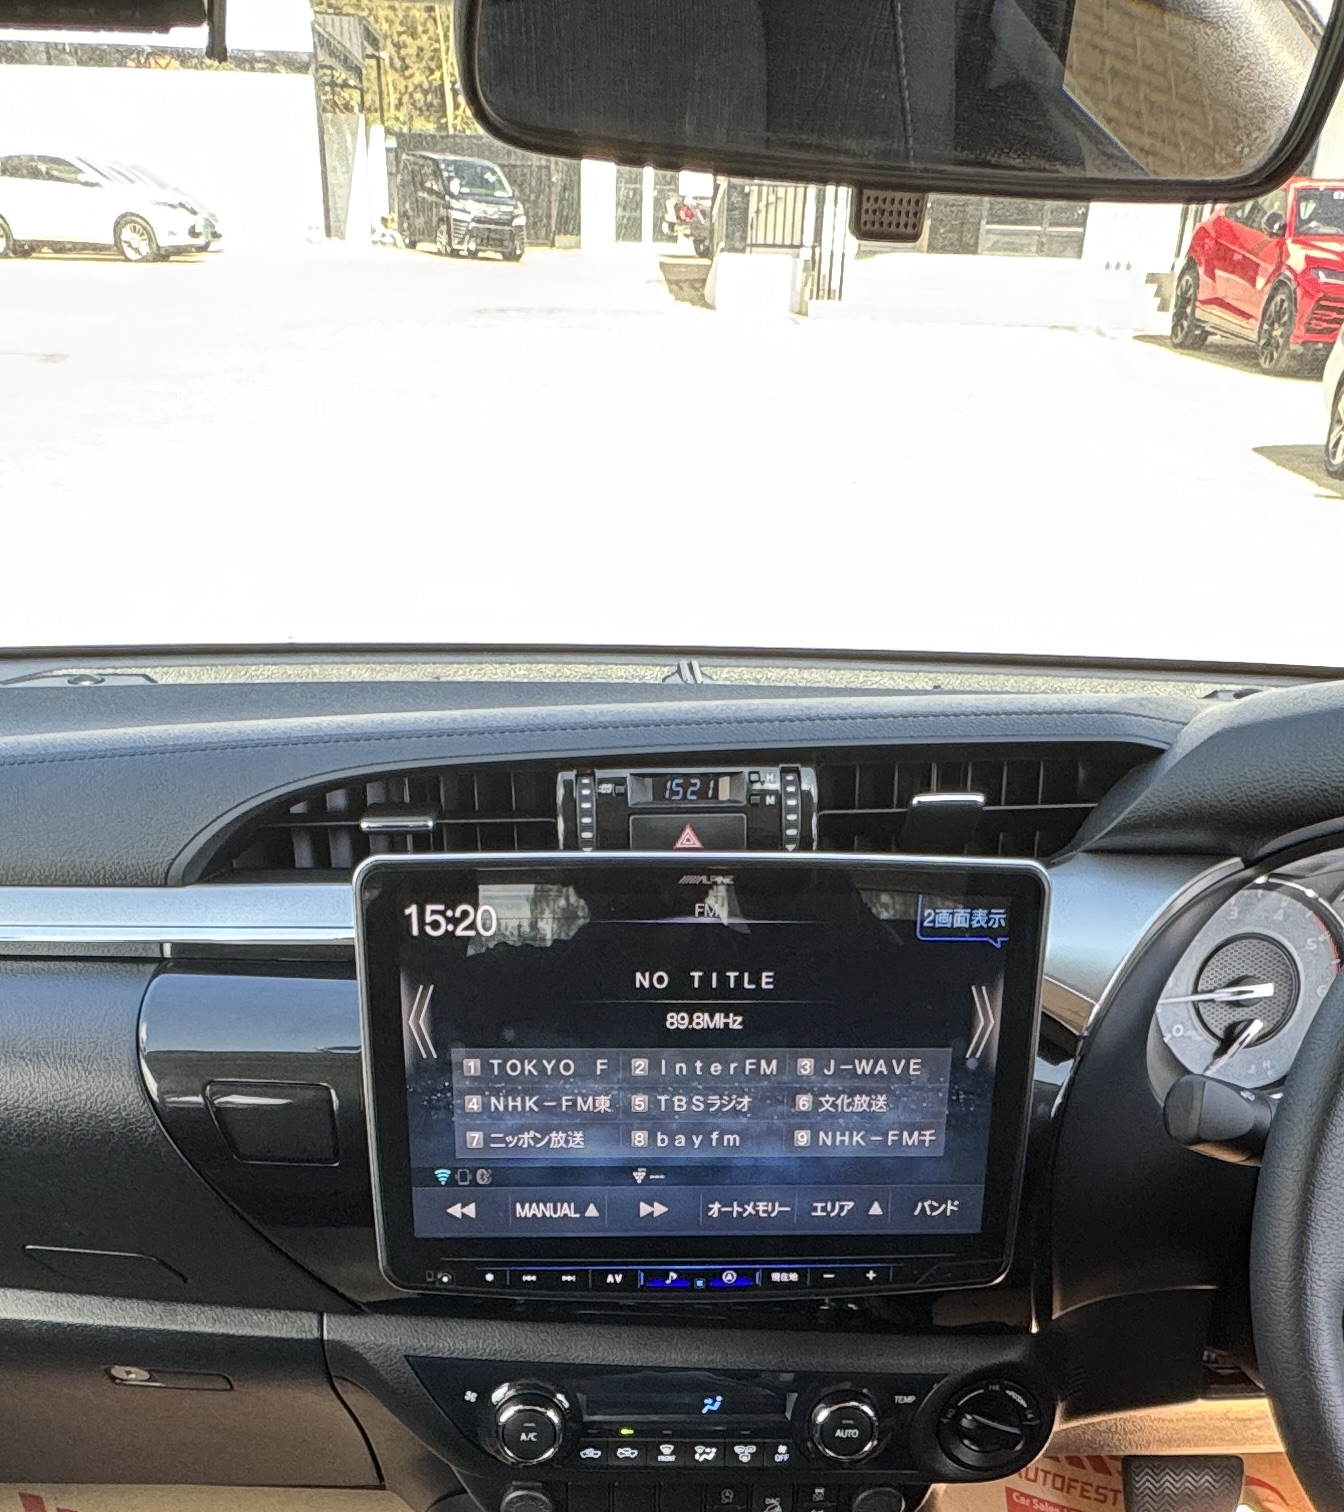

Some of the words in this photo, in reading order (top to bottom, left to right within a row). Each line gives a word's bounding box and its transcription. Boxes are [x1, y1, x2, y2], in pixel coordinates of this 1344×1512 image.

[694, 903, 720, 918] FM
[923, 908, 1007, 930] 2画面表示
[404, 903, 498, 938] 15:20
[634, 971, 669, 990] NO
[690, 971, 775, 990] TITLE
[666, 1012, 744, 1031] 89.8MHz
[489, 1058, 575, 1076] TOKYO
[596, 1058, 609, 1076] F
[661, 1058, 778, 1076] InterFM
[656, 1094, 753, 1113] TBSラジオ
[818, 1094, 888, 1112] 文化放送
[489, 1130, 586, 1149] ニッポン放送
[657, 1130, 740, 1149] bayfm
[516, 1202, 581, 1218] MANUAL
[707, 1200, 791, 1218] オートメモリー
[811, 1200, 855, 1217] エリア
[914, 1199, 959, 1217] バンド
[606, 1274, 623, 1284] AV
[894, 1394, 916, 1404] TEMP
[520, 1432, 538, 1443] A/C
[834, 1428, 859, 1439] AUTO
[774, 1453, 790, 1463] OFF
[1012, 1491, 1030, 1507] Car
